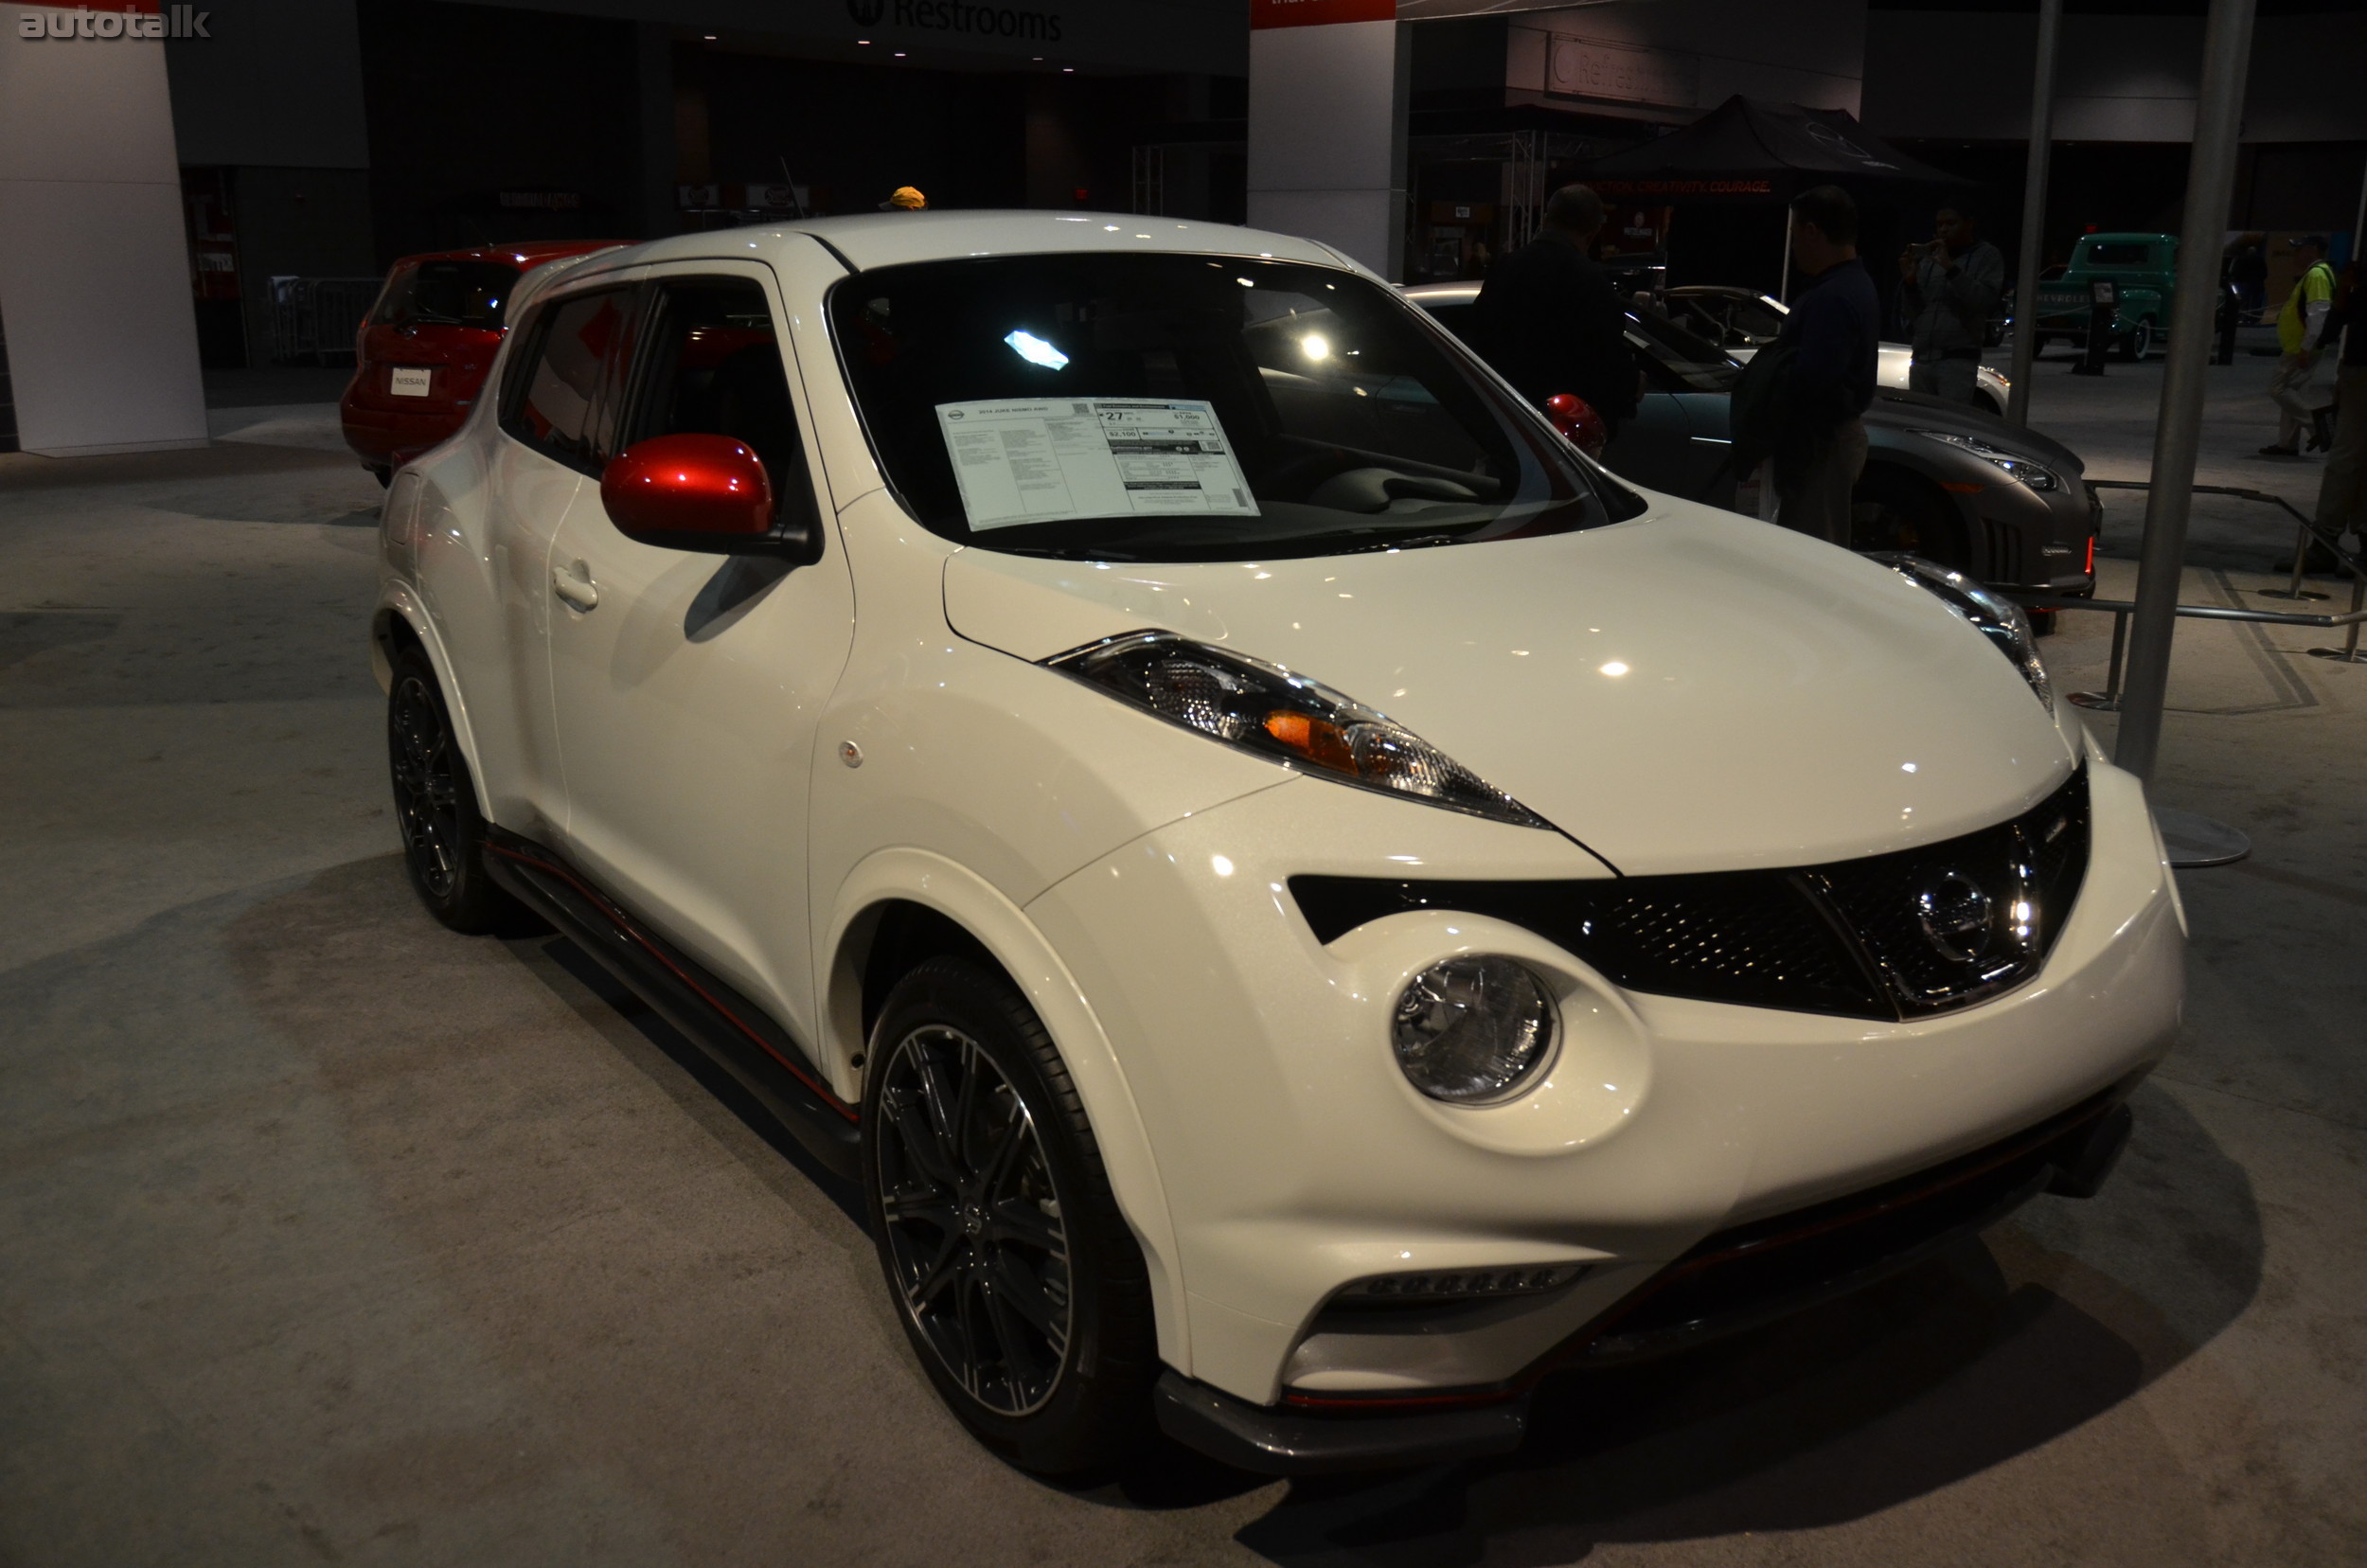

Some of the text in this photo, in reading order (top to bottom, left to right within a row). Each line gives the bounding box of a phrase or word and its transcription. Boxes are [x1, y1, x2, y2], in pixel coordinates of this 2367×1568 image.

[895, 0, 1061, 42] Restrooms
[395, 377, 426, 386] NISSAN
[1105, 412, 1124, 421] 27
